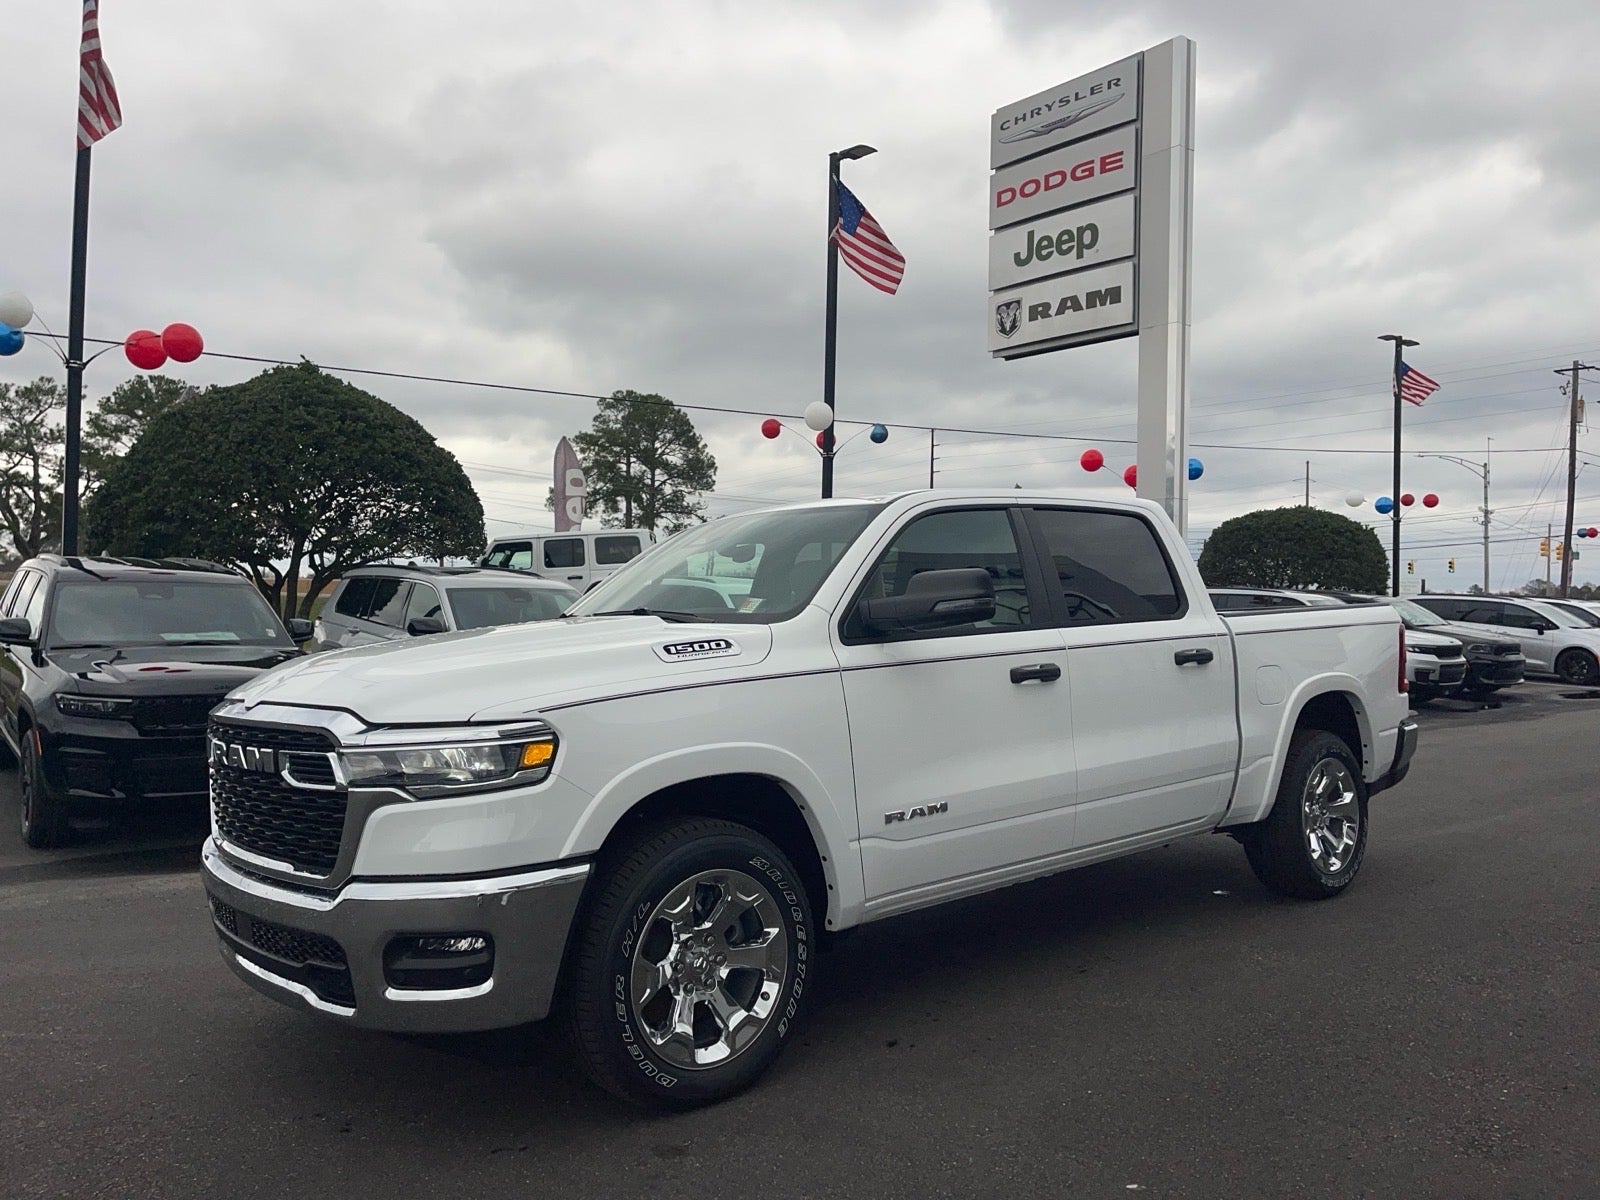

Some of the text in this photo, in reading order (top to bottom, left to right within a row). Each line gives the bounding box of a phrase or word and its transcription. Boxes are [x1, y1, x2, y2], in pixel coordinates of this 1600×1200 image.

[1000, 77, 1122, 131] CHRYSLER
[996, 150, 1125, 208] DODGE
[1013, 221, 1099, 267] Jeep
[1028, 285, 1122, 322] RAM
[666, 640, 727, 654] 1500
[211, 740, 275, 773] RAM
[883, 801, 949, 825] RAM
[748, 856, 808, 1039] BRIDGESTONE
[615, 973, 678, 1088] DUELER
